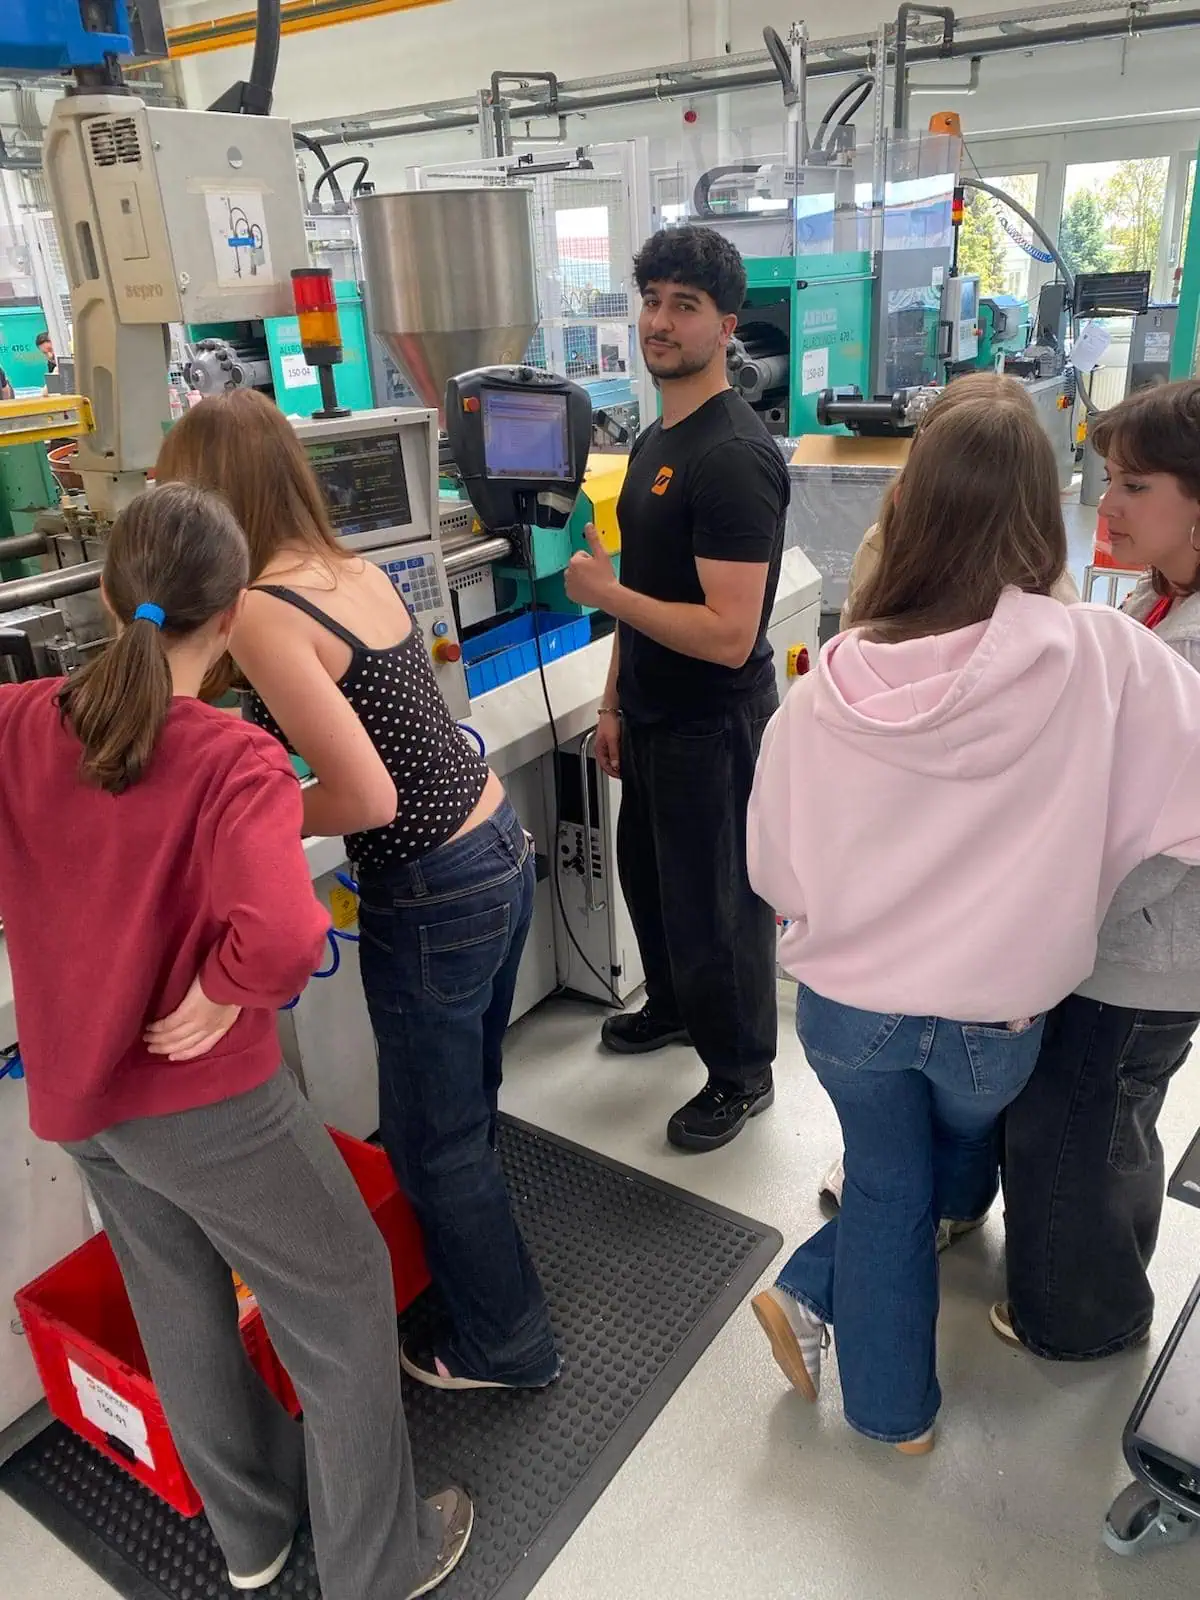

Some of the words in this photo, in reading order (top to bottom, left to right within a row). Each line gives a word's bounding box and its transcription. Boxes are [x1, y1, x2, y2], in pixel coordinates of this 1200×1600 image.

[125, 283, 163, 301] sepro
[11, 344, 25, 352] 470
[288, 367, 311, 378] 150-04
